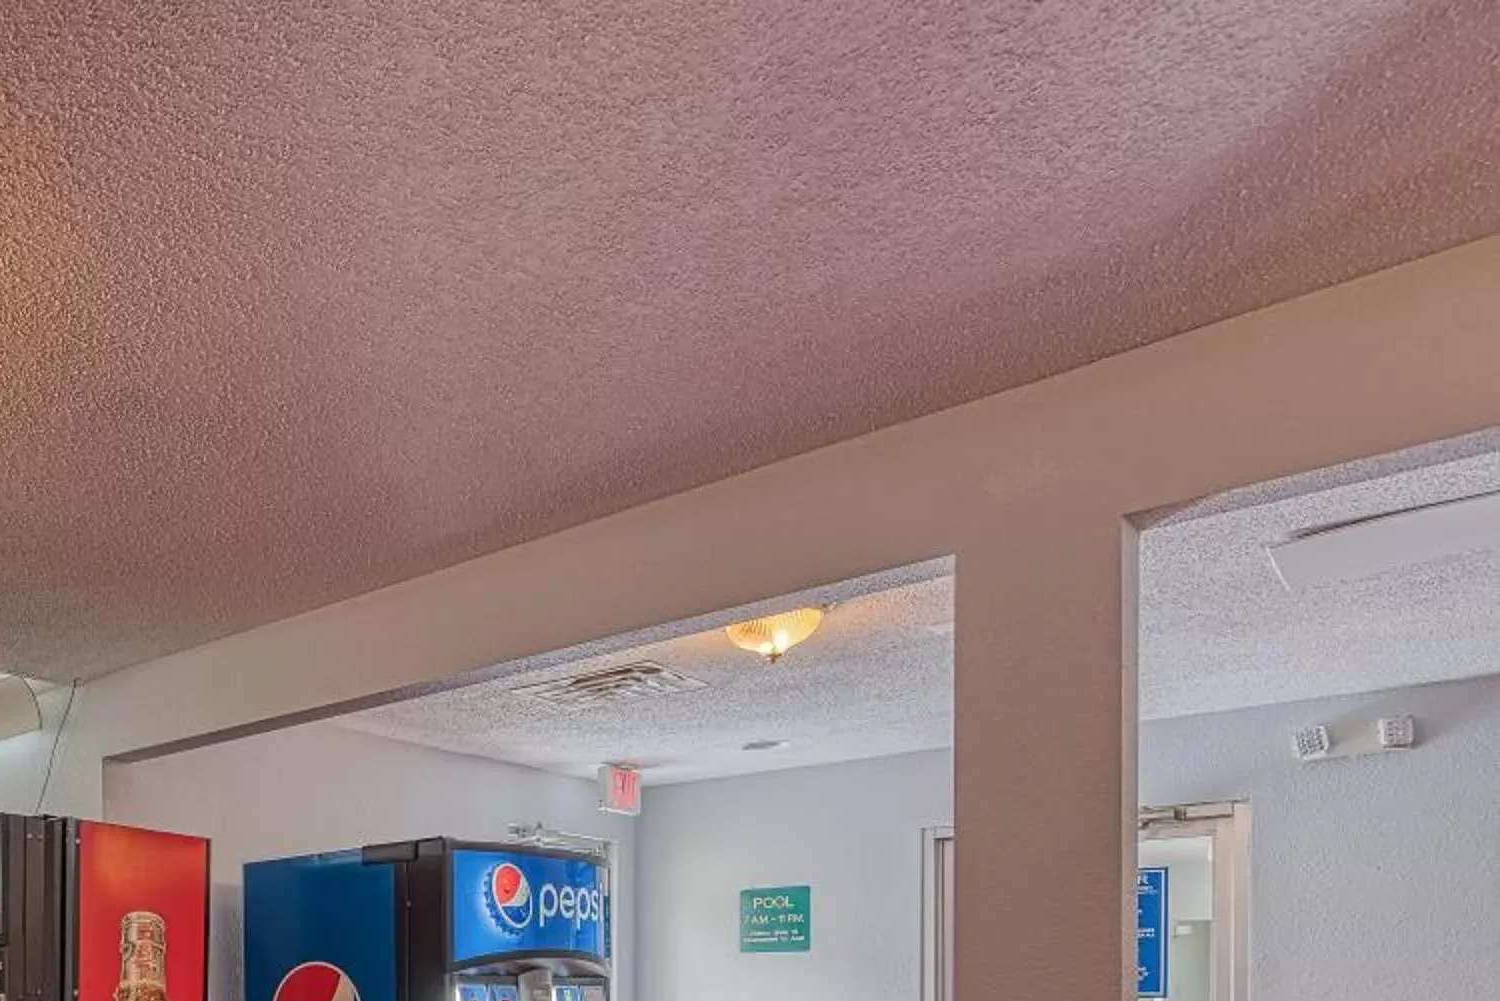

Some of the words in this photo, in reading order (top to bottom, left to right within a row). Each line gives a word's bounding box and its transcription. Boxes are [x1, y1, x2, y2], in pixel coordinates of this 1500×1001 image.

[540, 883, 604, 930] pepsi
[753, 896, 795, 909] POOL
[751, 914, 769, 925] AM
